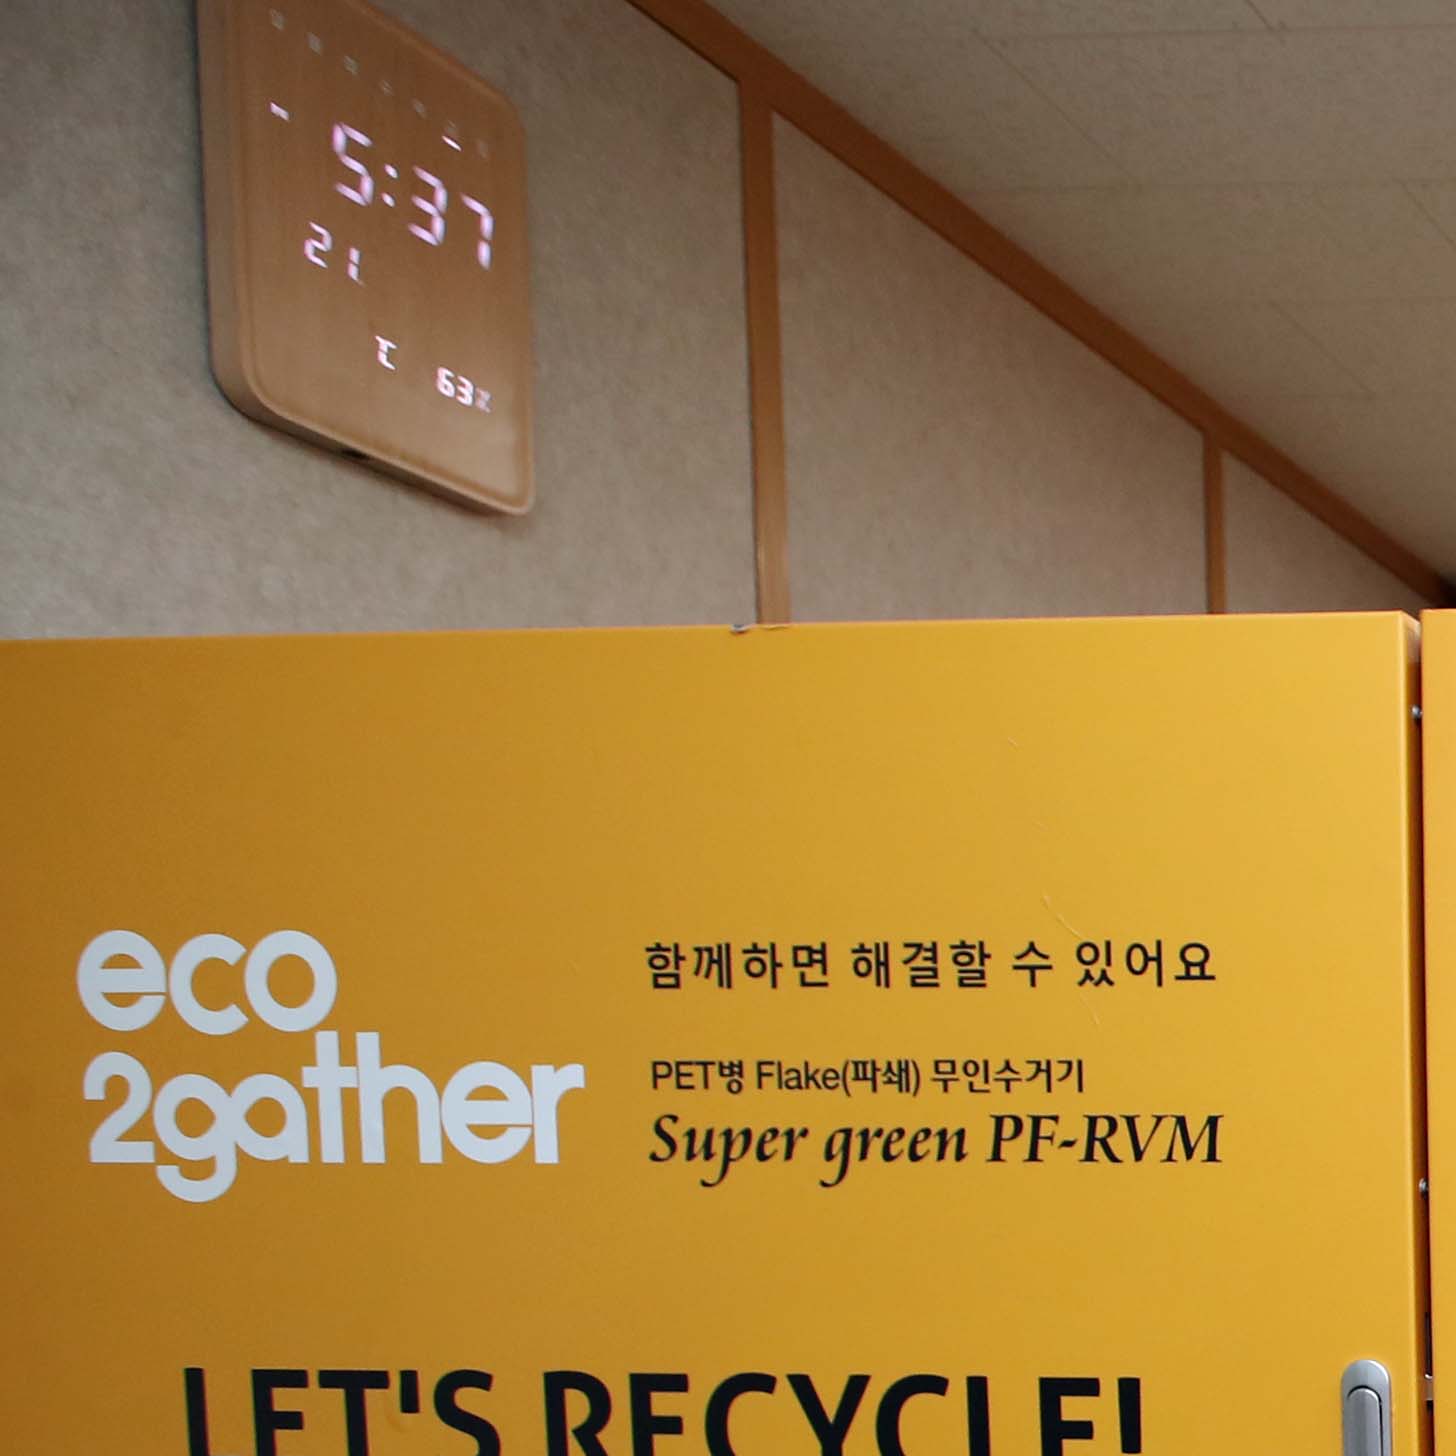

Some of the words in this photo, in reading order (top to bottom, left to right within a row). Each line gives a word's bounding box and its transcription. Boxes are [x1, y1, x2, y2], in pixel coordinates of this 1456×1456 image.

[332, 123, 493, 268] 5:37
[76, 930, 338, 1035] eco
[645, 941, 829, 990] 함께하면
[851, 940, 991, 989] 해결할
[1011, 940, 1054, 988] 수
[1075, 939, 1217, 988] 있어요
[83, 1031, 585, 1202] 2gather
[651, 1060, 745, 1095] PET병
[756, 1058, 921, 1097] Flake(파쇄)
[931, 1058, 1085, 1094] 무인수거기
[648, 1113, 809, 1188] Super
[818, 1124, 969, 1188] green
[985, 1113, 1224, 1165] PF-RVM
